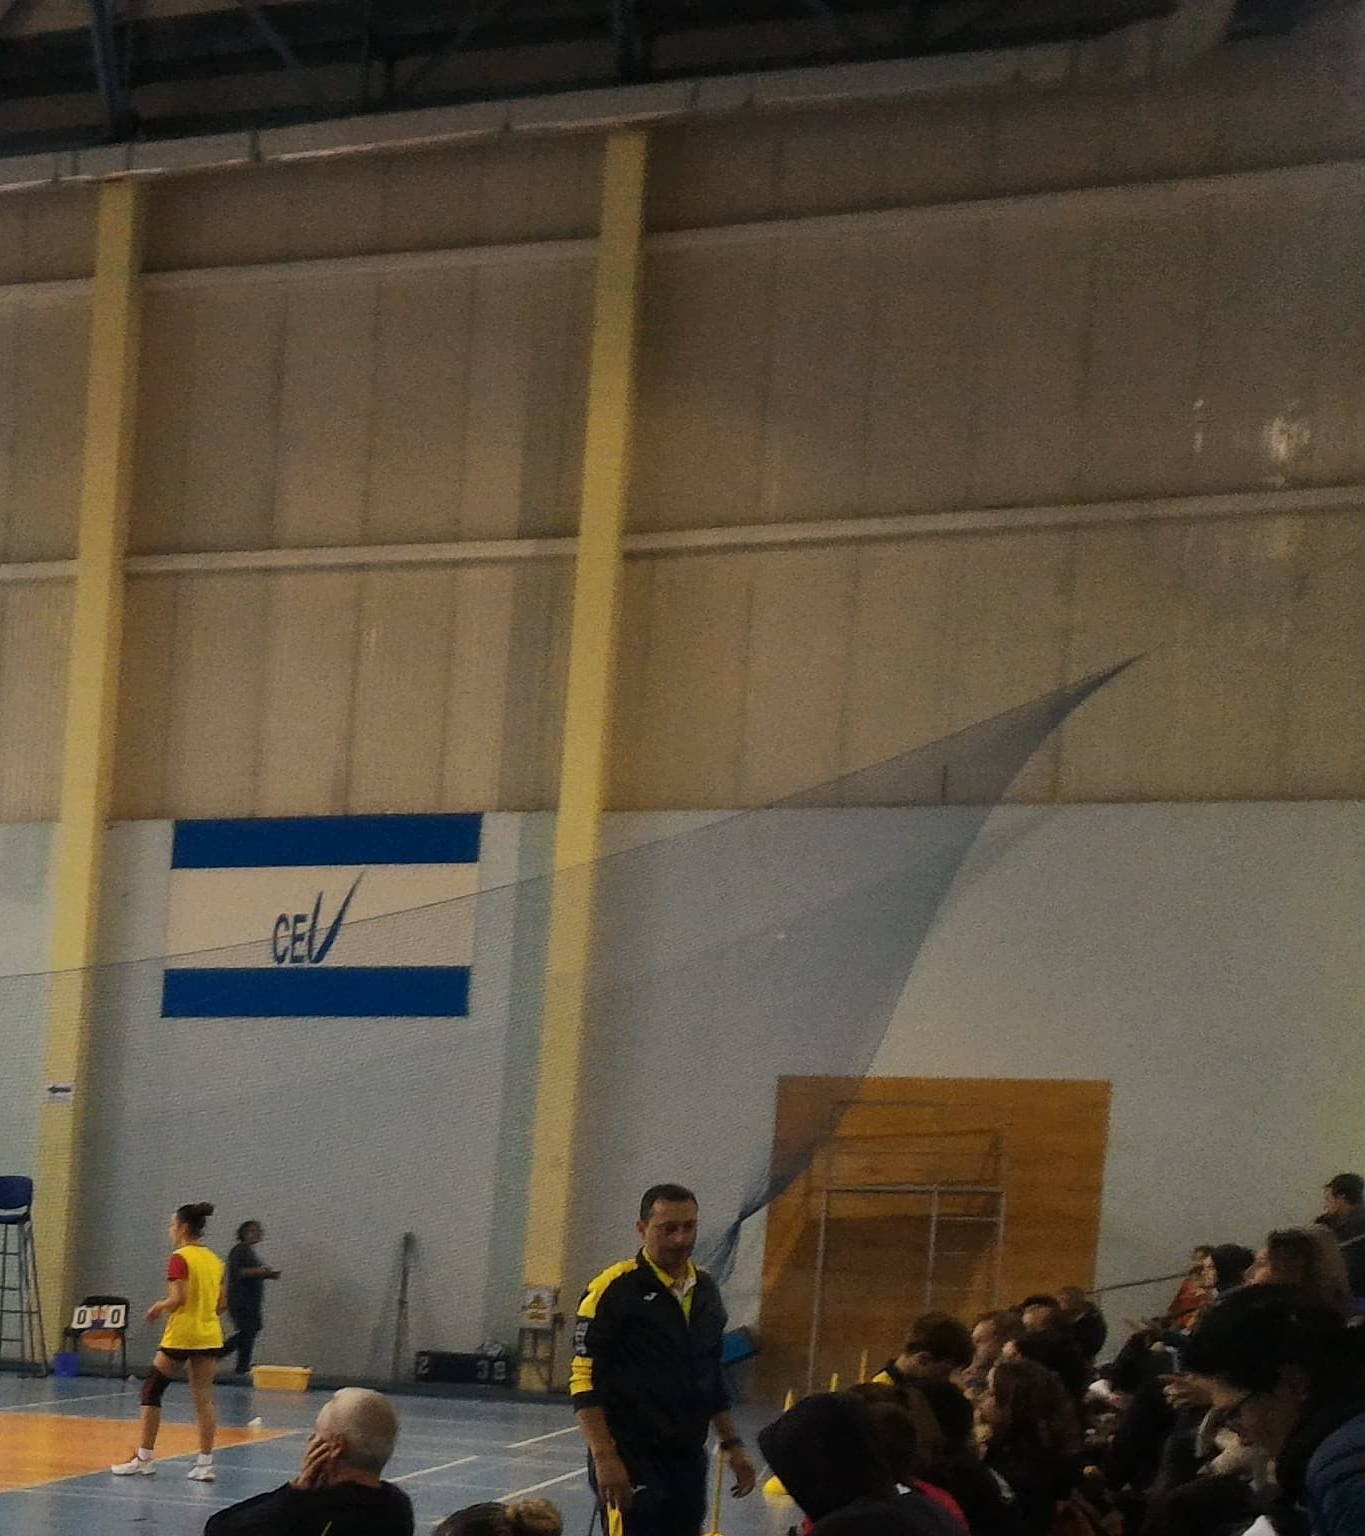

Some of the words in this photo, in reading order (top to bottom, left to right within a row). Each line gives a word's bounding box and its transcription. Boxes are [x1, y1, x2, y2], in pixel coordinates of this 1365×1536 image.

[273, 870, 366, 964] CEV
[77, 1309, 87, 1325] 0
[111, 1309, 121, 1325] 0
